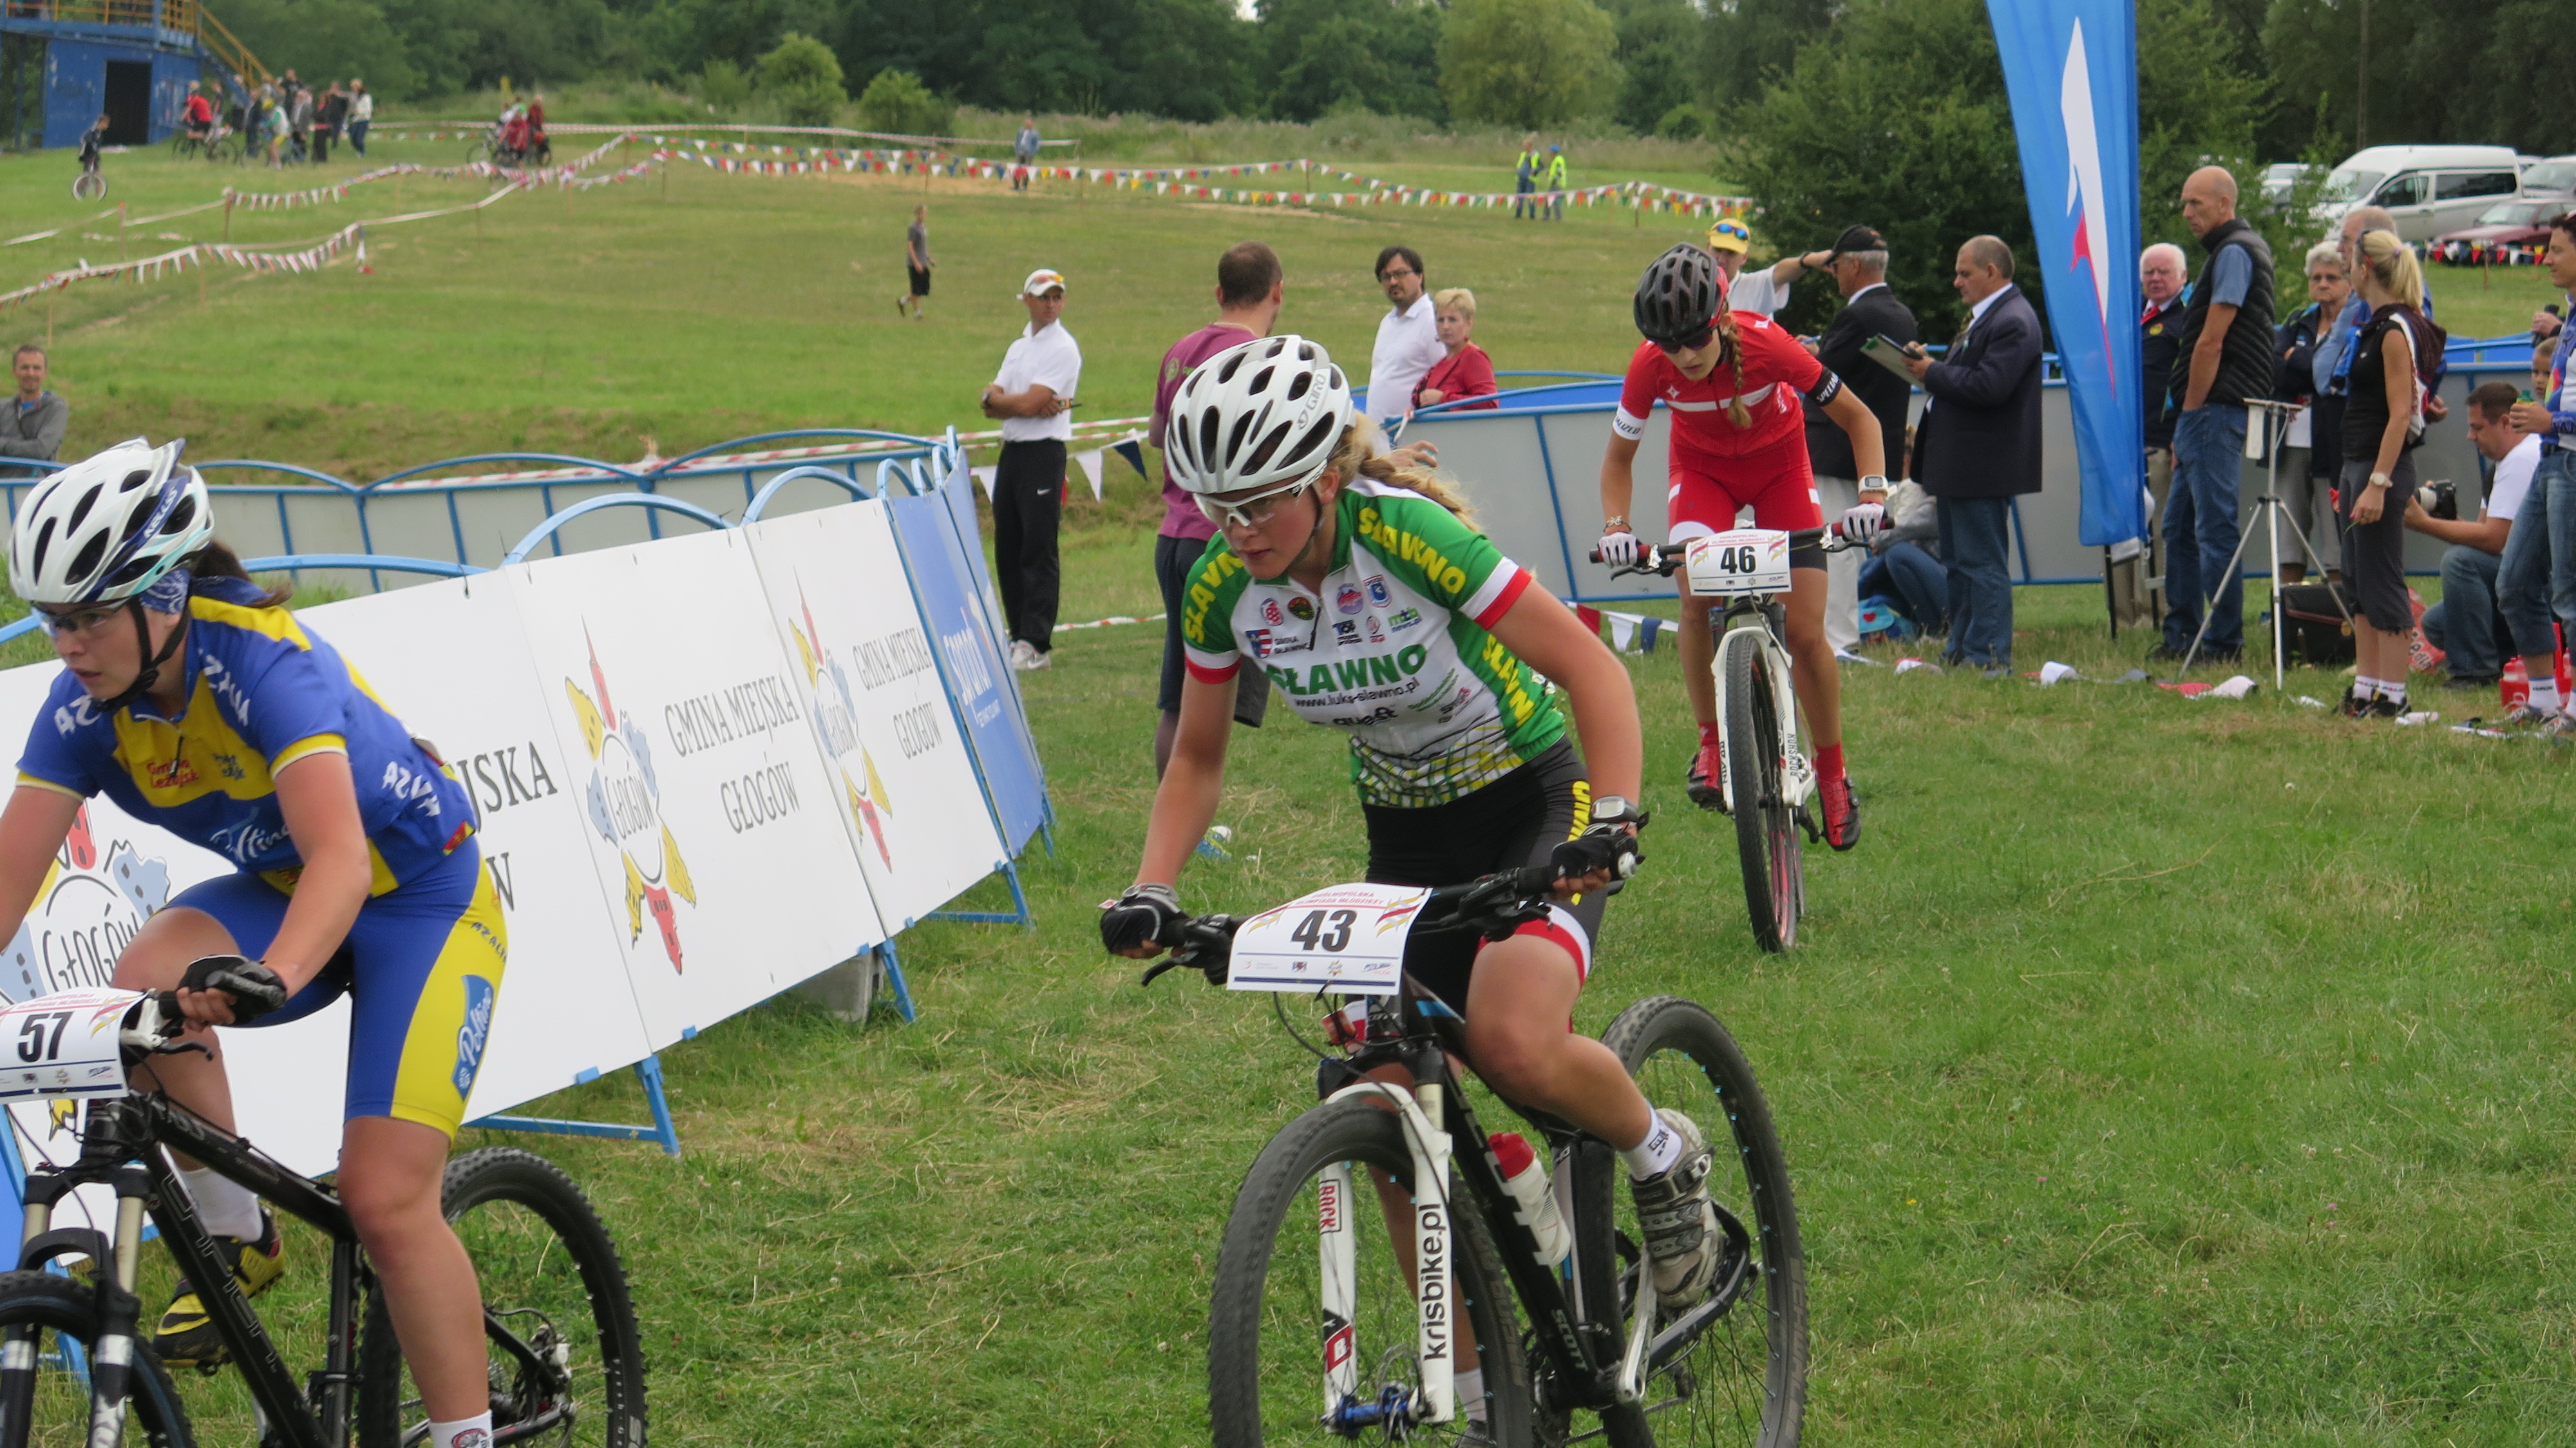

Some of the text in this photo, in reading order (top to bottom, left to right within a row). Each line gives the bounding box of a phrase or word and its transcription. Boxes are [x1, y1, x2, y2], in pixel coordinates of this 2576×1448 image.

[1305, 374, 1327, 410] GIRO
[1615, 416, 1642, 435] ALIZED
[1358, 507, 1466, 595] SŁAWNO
[1720, 546, 1757, 574] 46
[851, 625, 933, 691] GMINA MIEJSKA
[1266, 644, 1426, 696] SŁAWNO
[664, 673, 800, 757] GMINA MIEJSKA
[891, 691, 943, 760] GŁOGÓW
[456, 741, 558, 834] JSKA
[720, 751, 801, 835] GŁOGÓW
[1291, 909, 1358, 953] 43
[17, 1011, 76, 1063] 57
[1418, 1203, 1448, 1362] krisbike.pl
[1550, 1308, 1589, 1373] SCOTT
